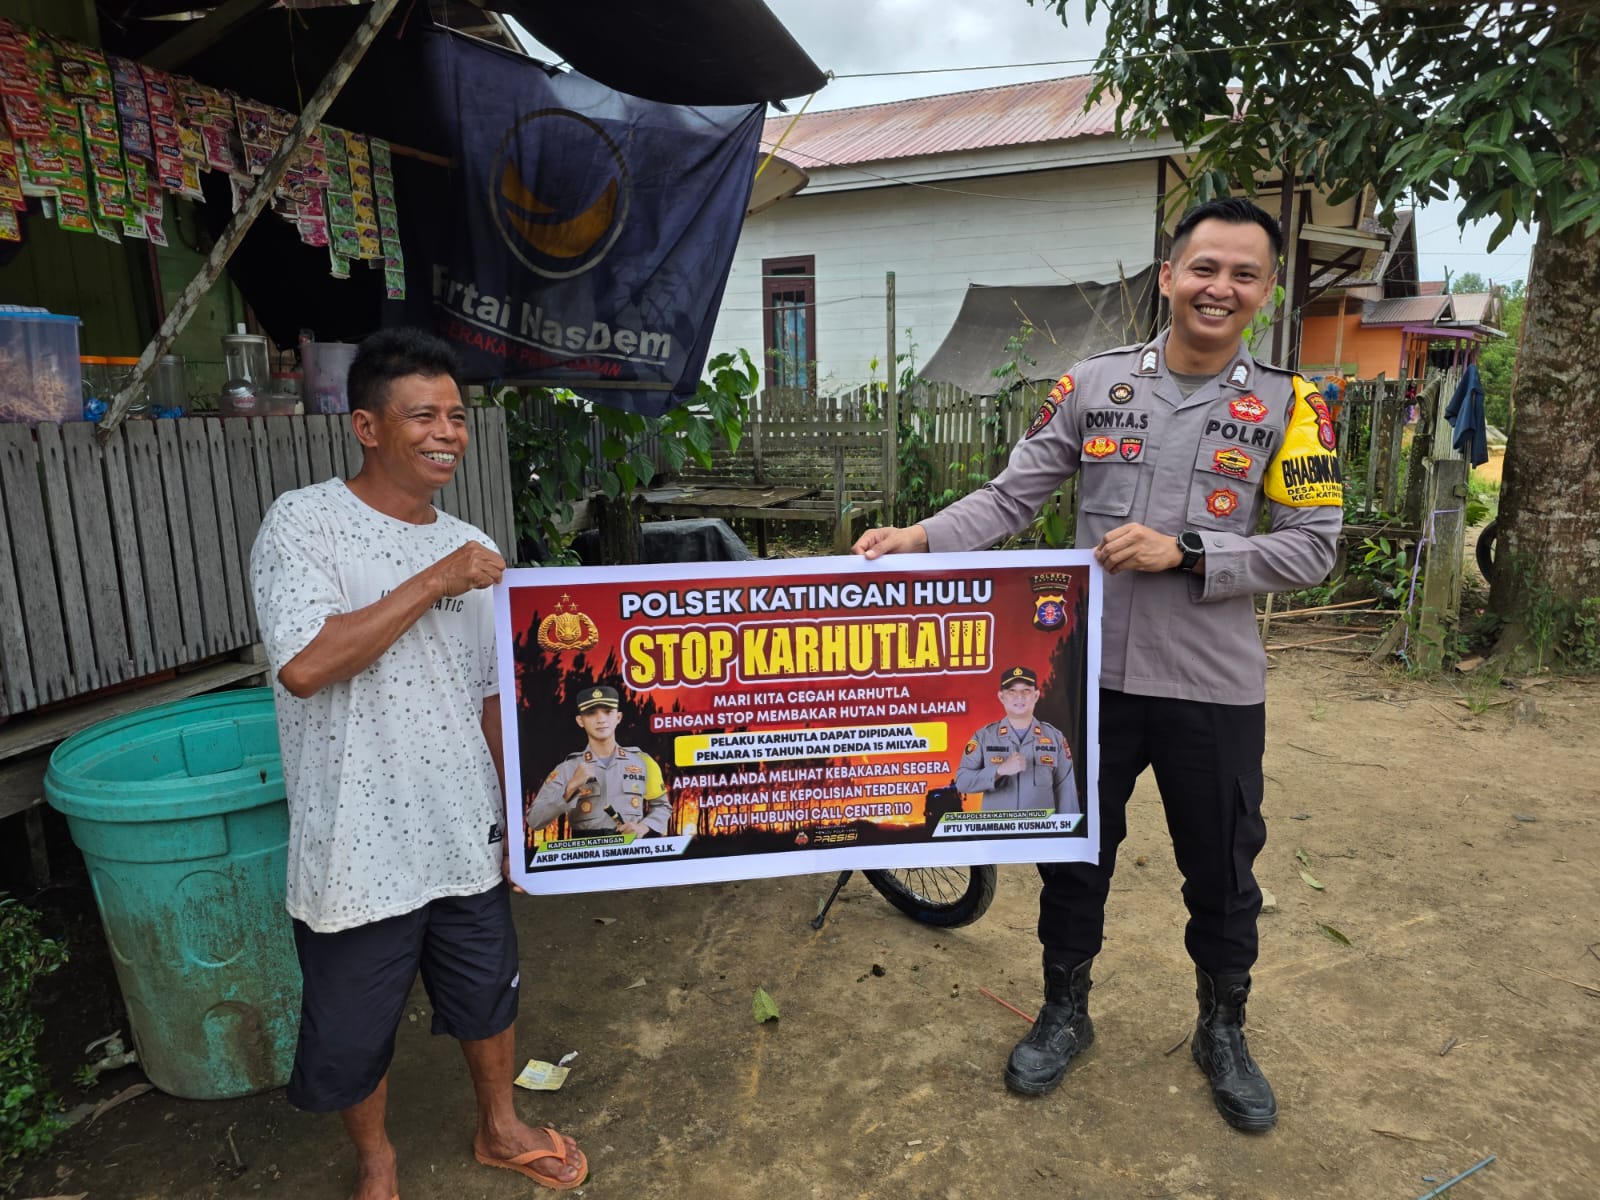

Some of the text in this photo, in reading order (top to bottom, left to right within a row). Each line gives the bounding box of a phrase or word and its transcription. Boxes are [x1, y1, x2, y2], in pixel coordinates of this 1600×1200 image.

[520, 302, 671, 358] NasDem
[1086, 411, 1148, 429] DONY.A.S
[1205, 420, 1274, 448] POLRI
[1292, 493, 1314, 502] KEC.
[622, 580, 992, 617] POLSEK KATINGAN HULU
[629, 630, 733, 684] STOP
[743, 622, 940, 676] KARHUTLA
[713, 686, 910, 707] MARI KITA CEGAH KARHUTLA
[653, 701, 966, 729] DENGAN STOP MEMBAKAR HUTAN DAN LAHAN
[711, 727, 913, 747] PELAKU KARHUTLA DAPAT DIPIDANA
[696, 739, 927, 762] PENJARA 15 TAHUN DAN DENDA 15 MILYAR
[673, 761, 950, 790] APABILA ANDA MELIHAT KEBAKARAN SEGERA
[699, 782, 927, 808] LAPORKAN KE KEPOLISIAN TERDEKAT
[715, 803, 912, 827] ATAU HUBUNGI CALL CENTER 110
[957, 811, 991, 820] KAPOLSEK
[993, 810, 1027, 819] KATINGAN
[1029, 809, 1047, 817] HULU
[814, 833, 858, 842] PRESISI
[944, 820, 1072, 833] IPTU YUBAMBANG KUSNADY, SH
[536, 844, 676, 863] AKBP CHANDRA ISMAWANTO, S.I.K.
[548, 836, 624, 850] KAPOLRES KATINGAN
